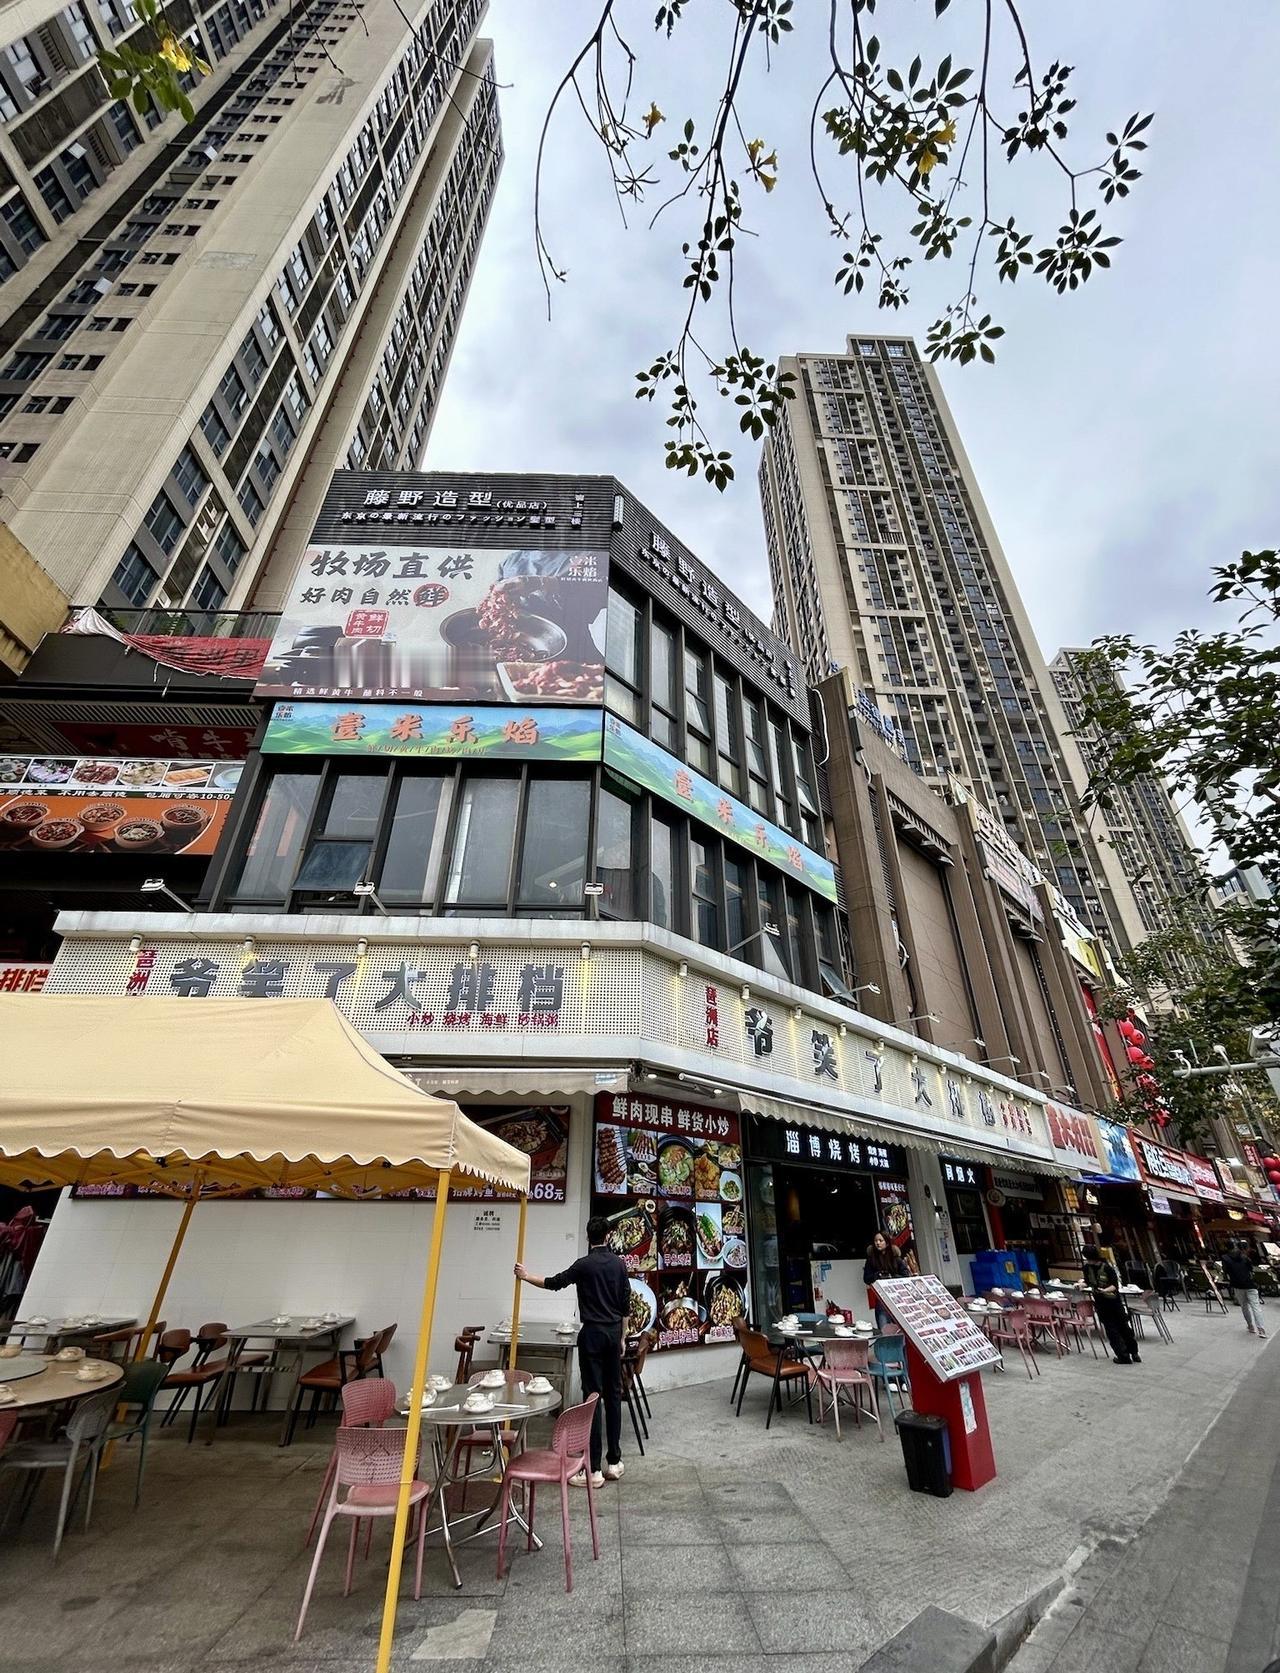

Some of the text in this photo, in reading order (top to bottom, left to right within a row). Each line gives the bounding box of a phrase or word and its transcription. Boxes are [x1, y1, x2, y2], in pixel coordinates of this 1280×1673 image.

[363, 490, 492, 506] 藤野造型
[310, 550, 475, 579] 牧场直供
[652, 531, 740, 628] 藤野造型
[301, 583, 448, 606] 好肉自然鲜
[293, 687, 353, 697] 精选鲜黄牛
[332, 711, 540, 745] 壹米乐焰
[674, 768, 804, 871] 壹米乐焰
[170, 957, 564, 1012] 爷笑了大排档
[407, 1011, 559, 1027] 小炒 烧烤 海鲜 砂锅粥
[612, 1096, 730, 1136] 鲜肉现串 鲜货小炒
[785, 1129, 861, 1164] 淄博烧烤
